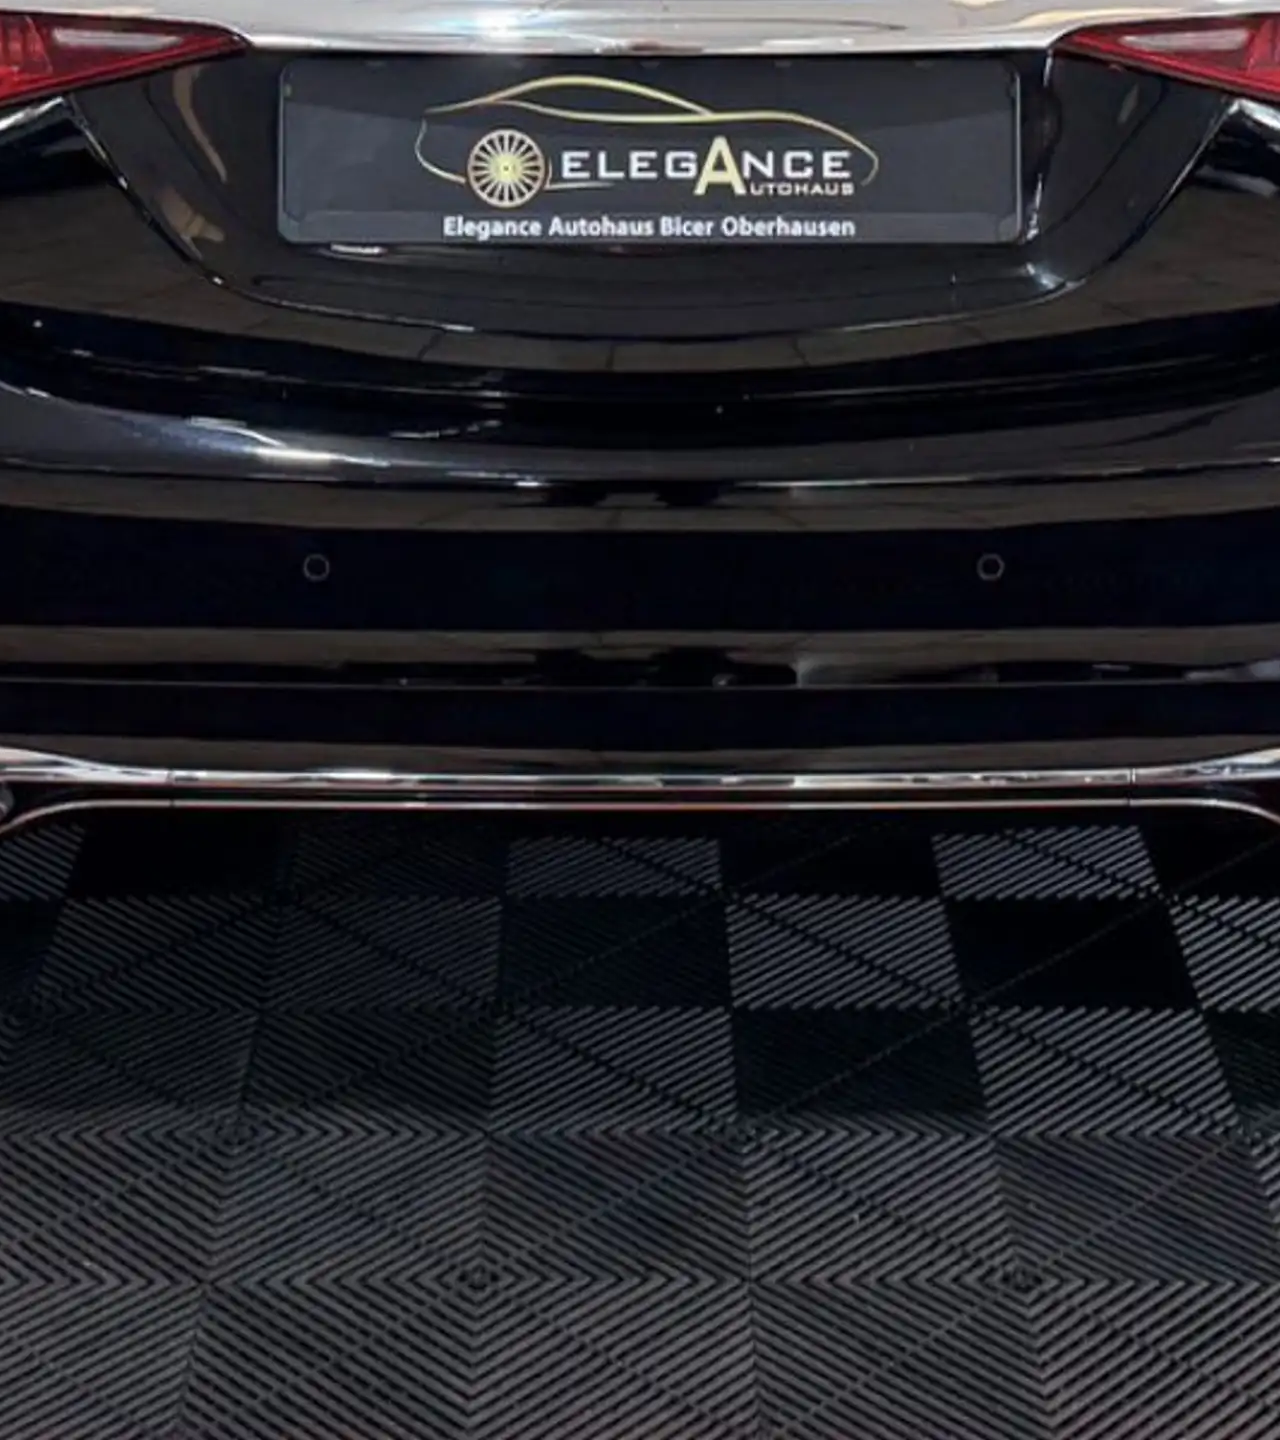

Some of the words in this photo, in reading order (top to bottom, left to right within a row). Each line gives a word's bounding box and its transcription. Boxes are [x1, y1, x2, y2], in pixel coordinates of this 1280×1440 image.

[560, 136, 852, 196] ELEGANCE
[443, 215, 542, 242] Elegance
[548, 215, 655, 238] Autohaus
[660, 215, 714, 238] Bicer
[721, 215, 856, 238] Oberhausen
